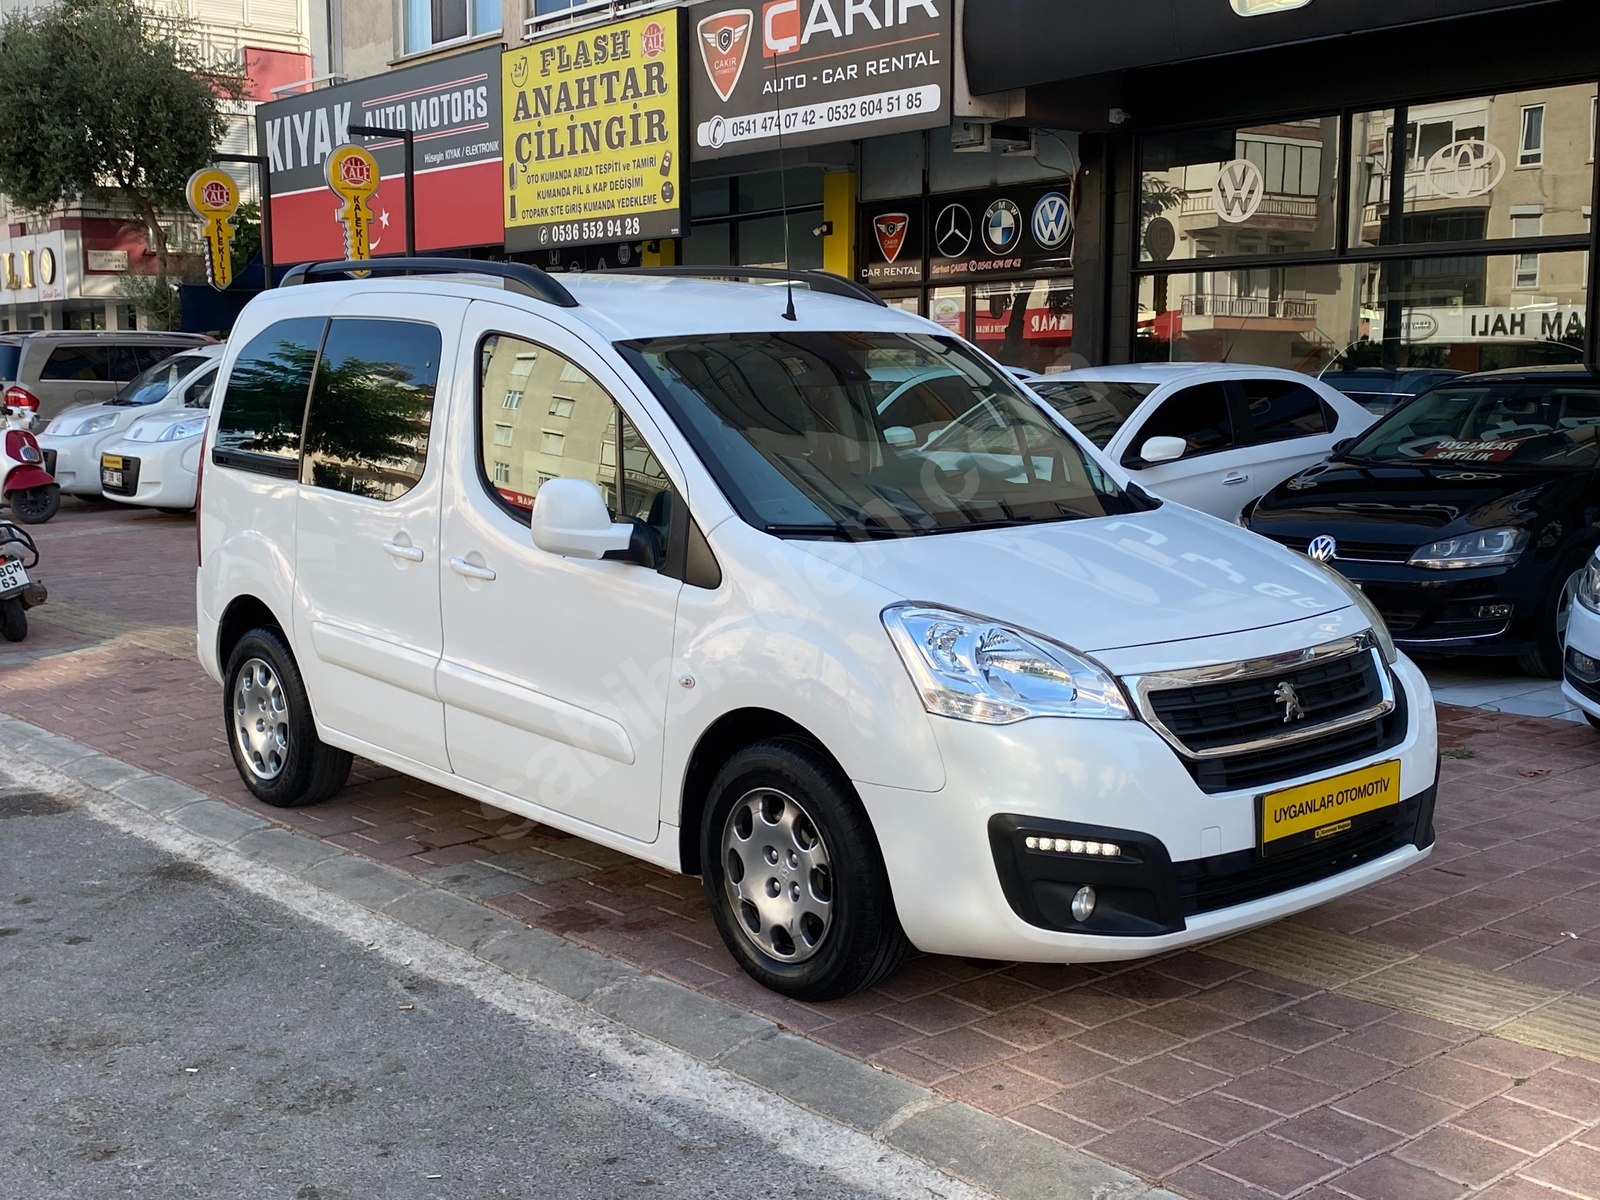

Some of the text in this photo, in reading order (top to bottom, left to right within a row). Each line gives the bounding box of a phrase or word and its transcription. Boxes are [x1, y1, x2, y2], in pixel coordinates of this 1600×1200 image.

[540, 29, 630, 77] FLASH
[641, 33, 665, 57] KALE
[762, 73, 807, 95] AUTO
[822, 63, 858, 85] CAR
[866, 49, 941, 75] RENTAL
[512, 61, 669, 123] ANAHTAR
[731, 119, 757, 137] 0541
[760, 115, 781, 133] 474
[784, 112, 798, 129] 07
[801, 109, 816, 126] 42
[826, 102, 857, 123] 0532
[860, 97, 883, 117] 604
[886, 95, 901, 112] 51
[906, 91, 923, 110] 85
[265, 85, 488, 173] KIYAK AUTO MOTORS
[514, 102, 669, 173] ÇİLİNGİR
[424, 150, 445, 164] Hüseyin
[445, 148, 461, 161] KIYAK
[340, 164, 372, 183] KALE
[526, 174, 539, 185] OTO
[541, 169, 573, 183] KUMANDA
[573, 166, 594, 178] ARIZA
[201, 187, 231, 205] KALE
[536, 186, 571, 200] KUMANDA
[572, 183, 583, 196] PİL
[593, 181, 608, 193] KAP
[521, 208, 549, 220] OTOPARK
[583, 198, 616, 213] KUMANDA
[617, 193, 658, 210] YEDEKLEME
[551, 216, 641, 242] 0536 552 94 28
[861, 265, 921, 278] CAR RENTAL
[1, 576, 18, 589] 63
[1273, 776, 1391, 824] UYGANLAR OTOMOTİV
